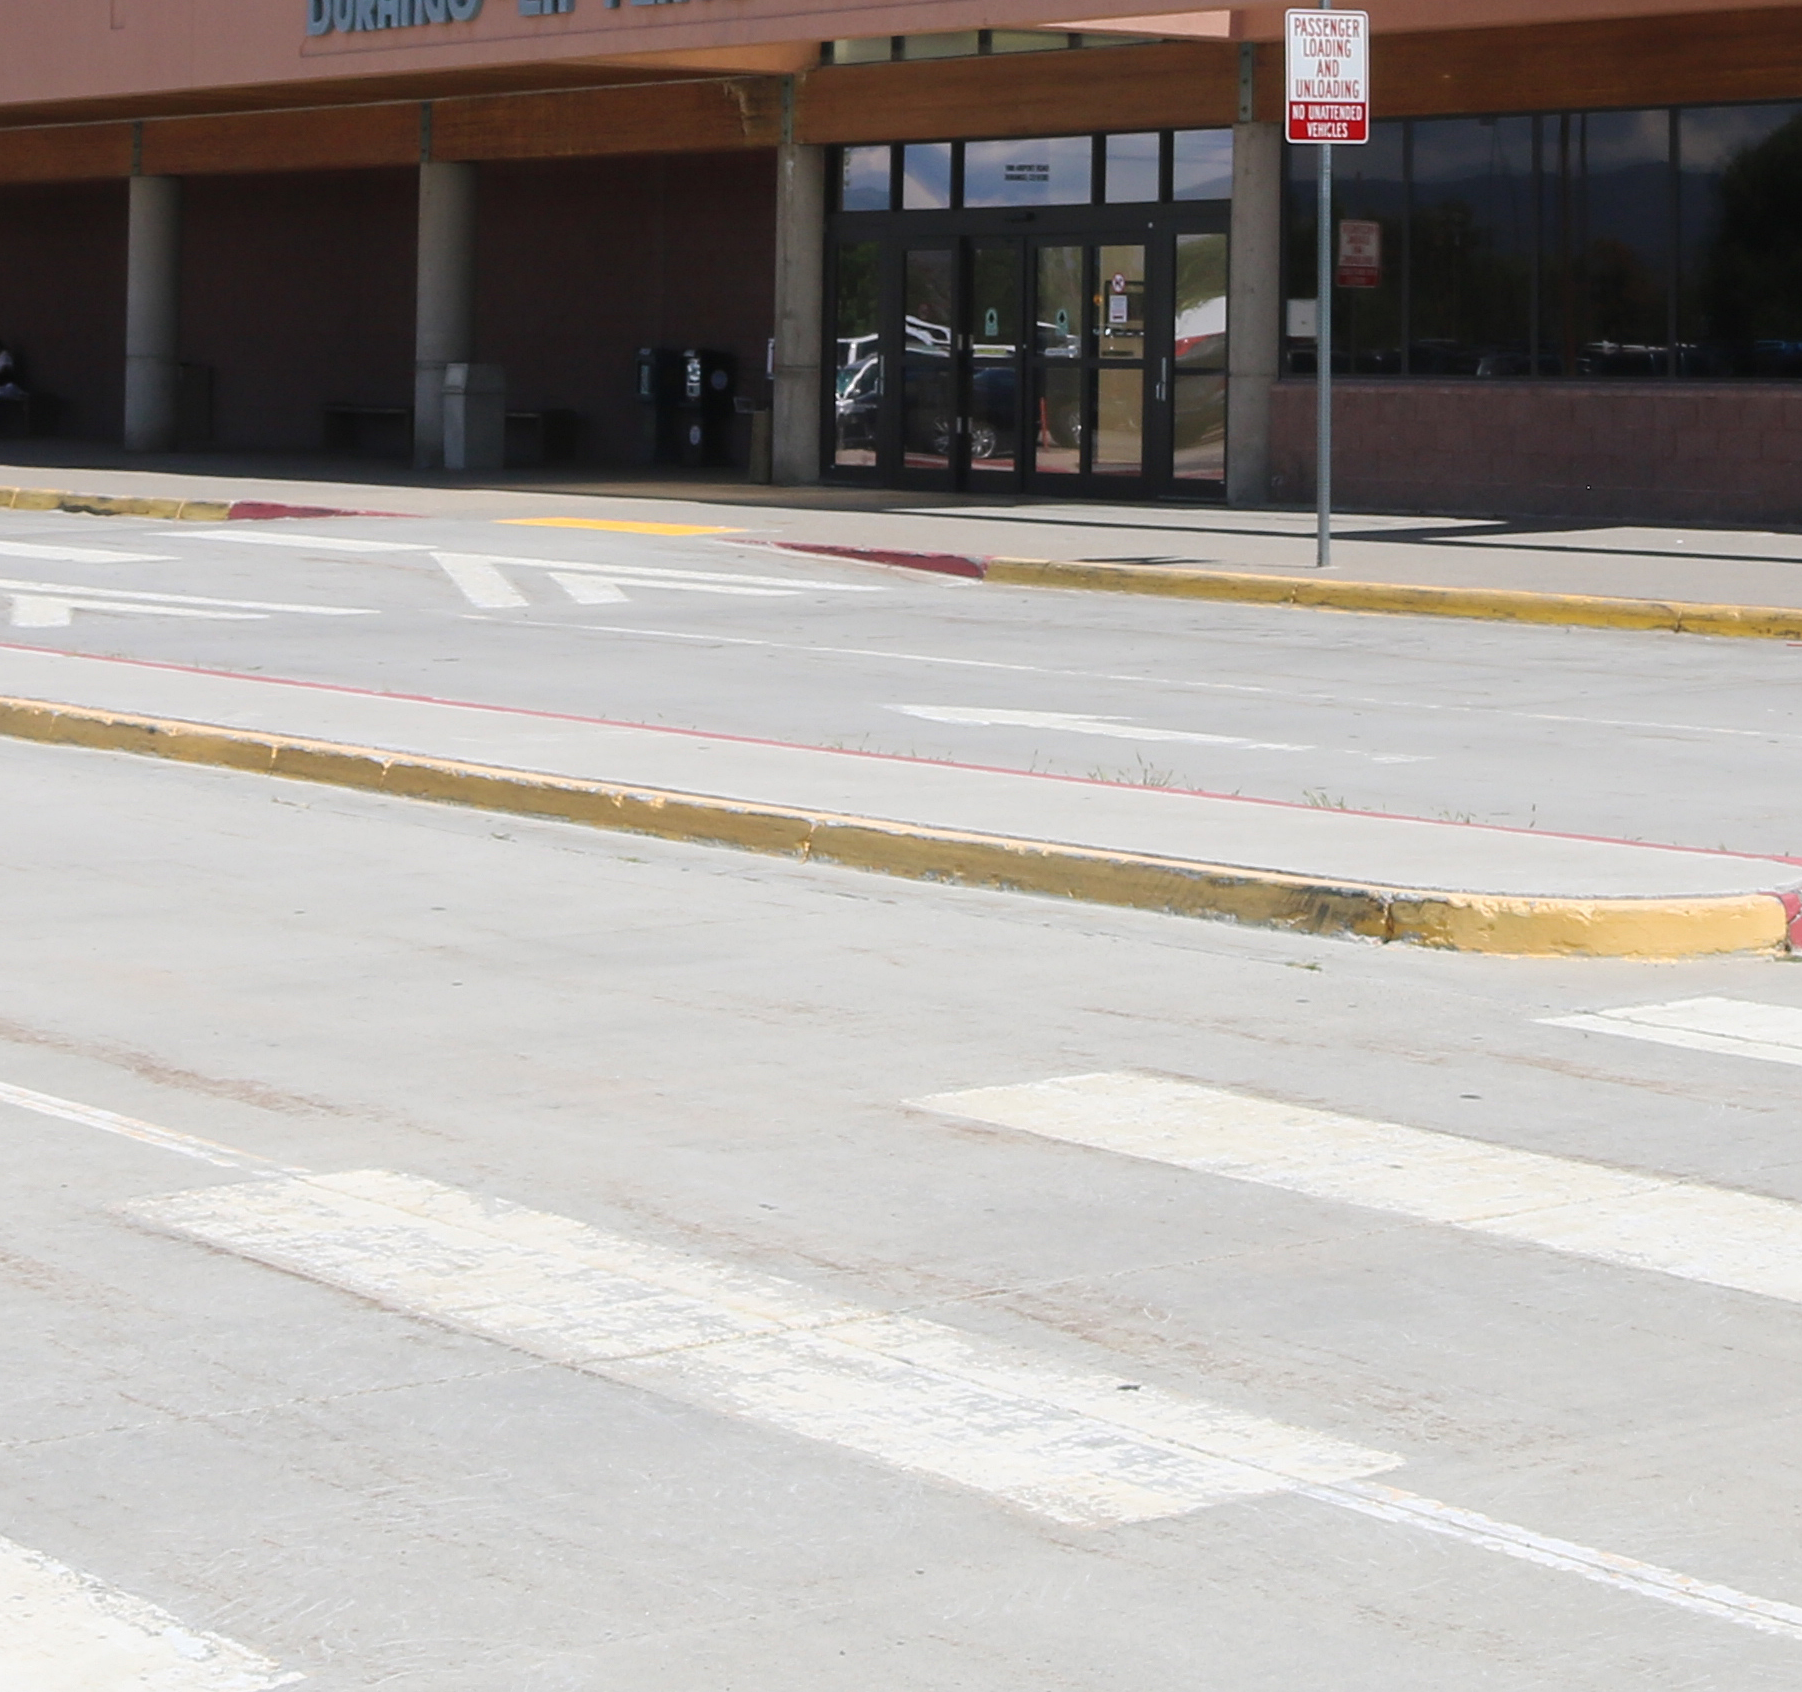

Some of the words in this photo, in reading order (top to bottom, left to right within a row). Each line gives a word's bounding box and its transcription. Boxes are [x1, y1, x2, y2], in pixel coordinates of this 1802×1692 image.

[1293, 16, 1361, 38] PASSENGER
[1302, 38, 1352, 59] LOADING
[1315, 59, 1340, 78] AND
[1295, 79, 1360, 100] UNLOADING
[1291, 104, 1305, 120] NO
[1307, 104, 1363, 121] UNATTENDED
[1306, 121, 1349, 138] VEHICLES
